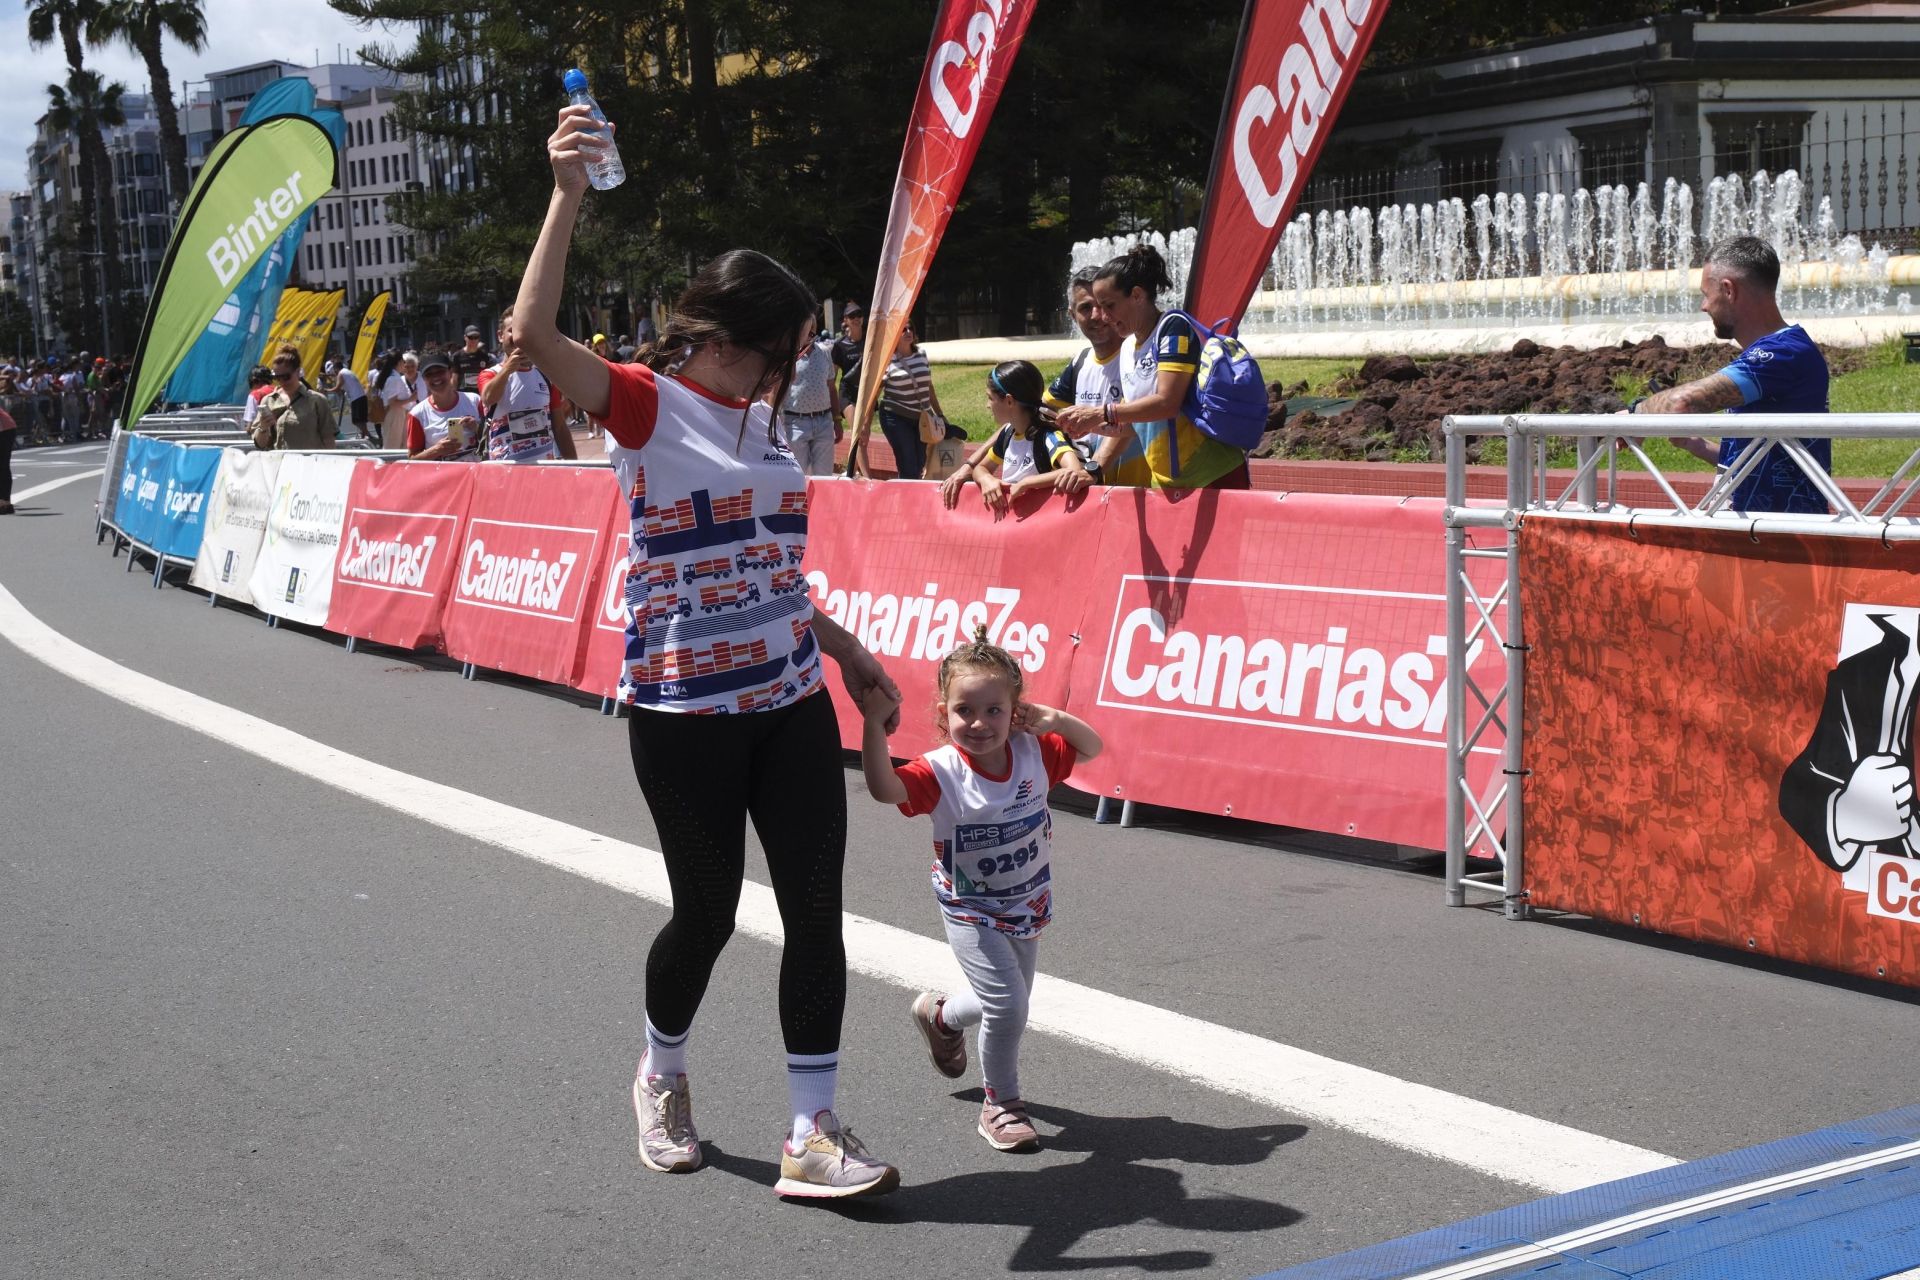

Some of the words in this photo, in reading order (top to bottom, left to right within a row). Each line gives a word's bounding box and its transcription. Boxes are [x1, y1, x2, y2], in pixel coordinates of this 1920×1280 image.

[1233, 0, 1372, 228] Can
[206, 171, 303, 288] Binter
[340, 526, 437, 588] Canarias7
[460, 538, 577, 611] Canarias7
[1111, 607, 1484, 734] Canarias7
[960, 826, 999, 842] HPS
[978, 839, 1038, 877] 9295
